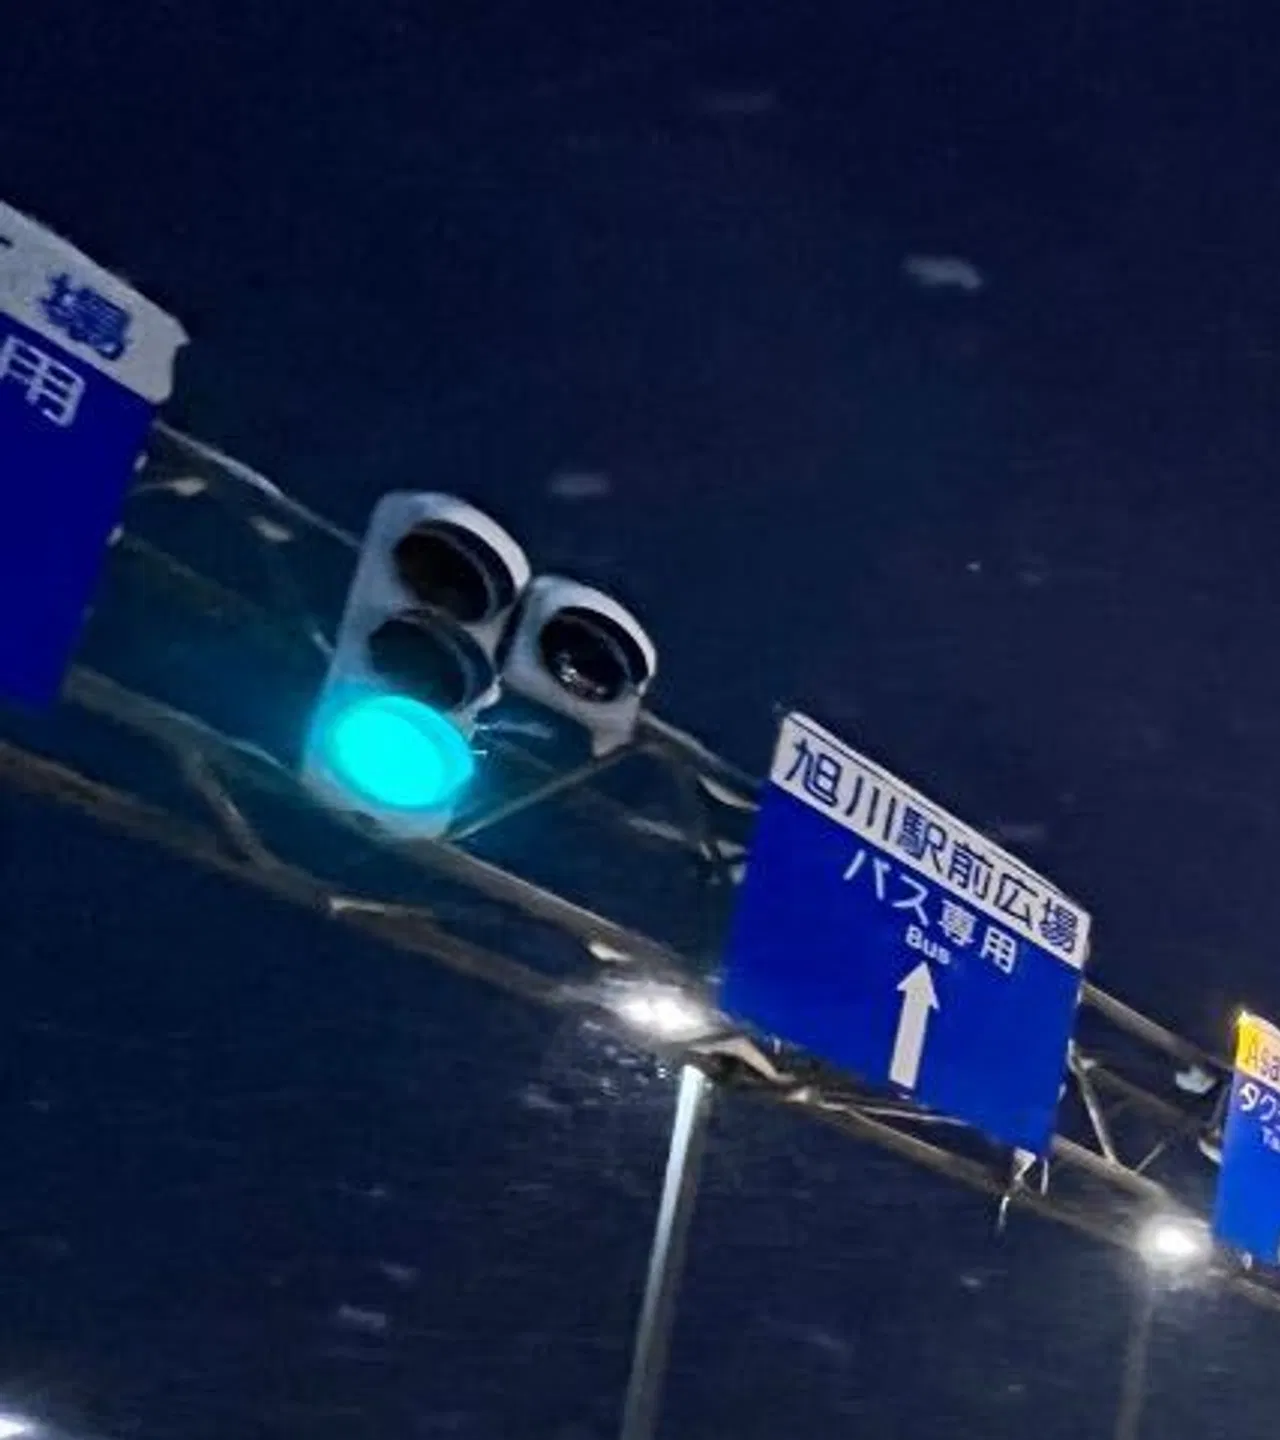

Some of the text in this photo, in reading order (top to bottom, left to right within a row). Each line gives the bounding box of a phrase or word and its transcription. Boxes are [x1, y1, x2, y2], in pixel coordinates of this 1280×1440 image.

[785, 739, 1079, 954] 旭川駅前広場
[843, 849, 1018, 974] バス専用
[905, 924, 951, 965] Bus
